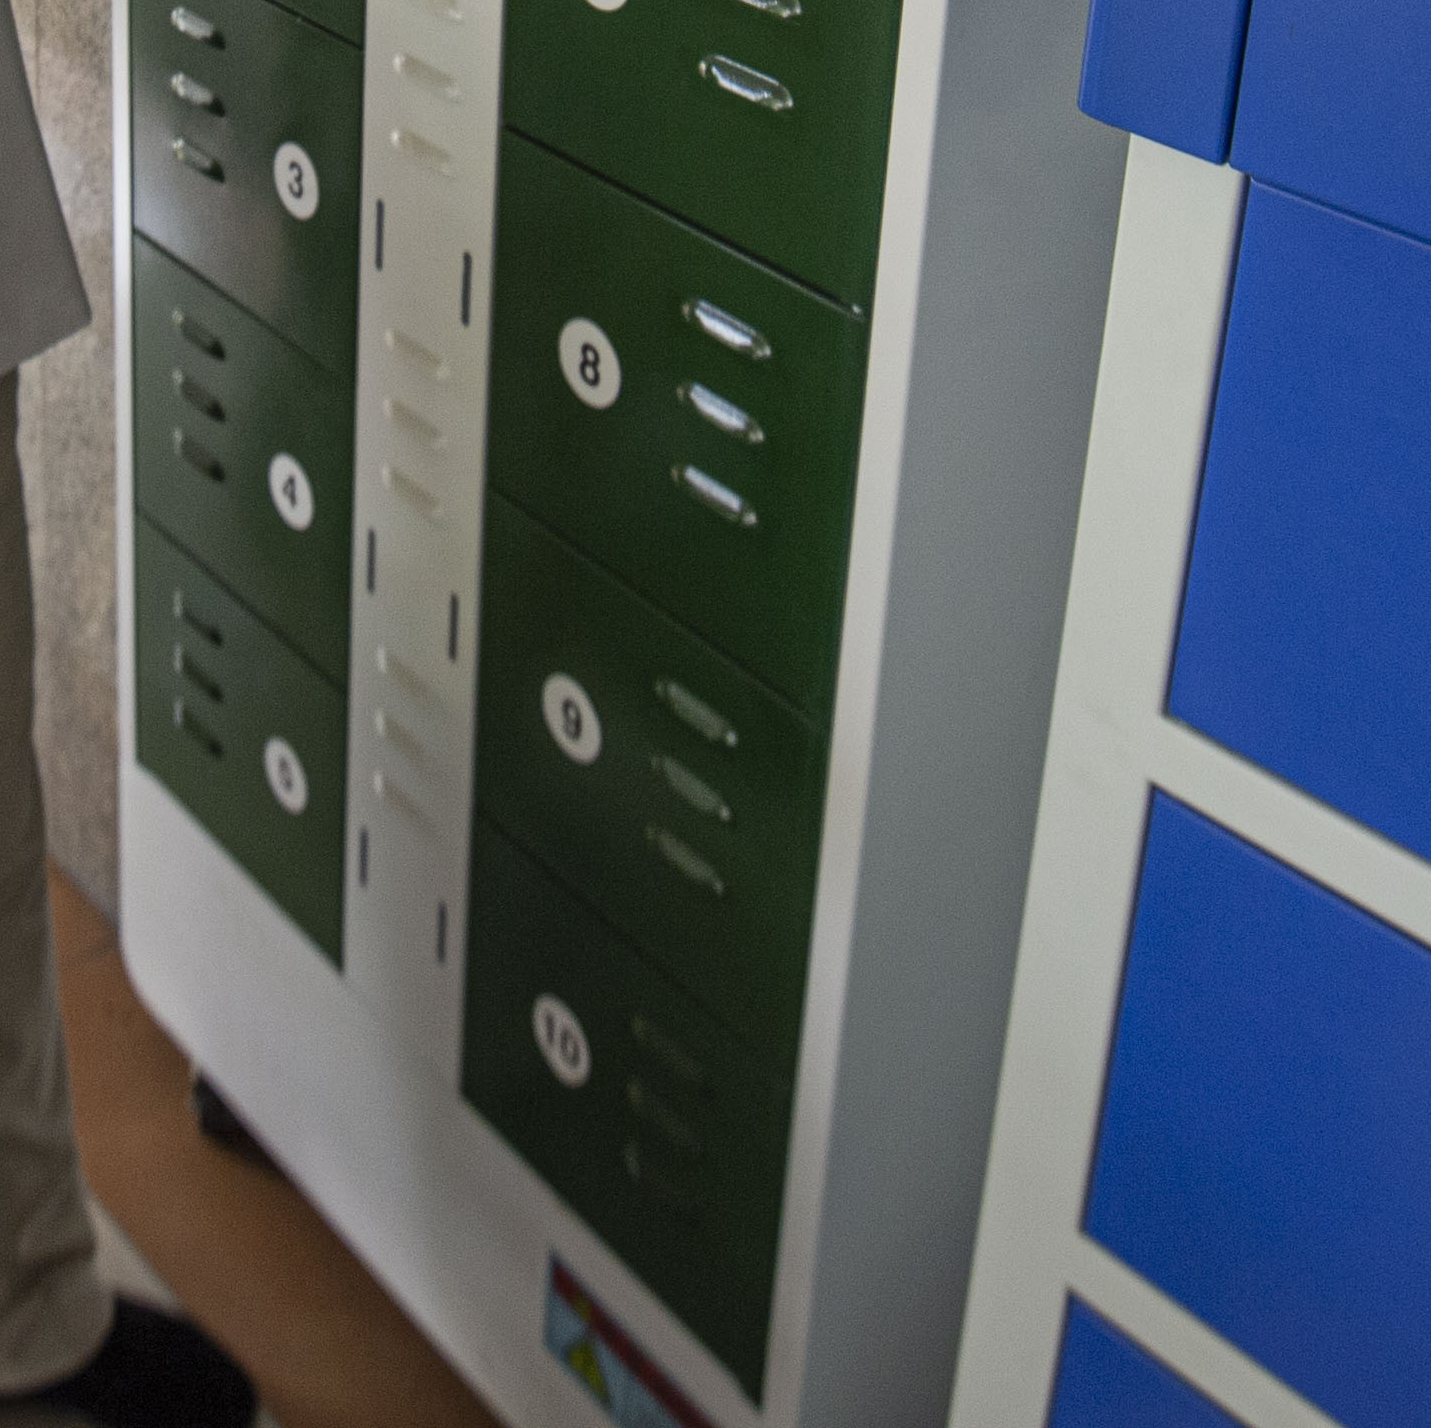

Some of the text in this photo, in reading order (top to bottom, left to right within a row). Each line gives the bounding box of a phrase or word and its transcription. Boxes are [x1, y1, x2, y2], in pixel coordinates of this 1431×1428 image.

[288, 160, 304, 201] 3
[579, 341, 601, 387] 8
[282, 475, 298, 508] 4
[561, 698, 583, 741] 9
[544, 1012, 581, 1070] 10
